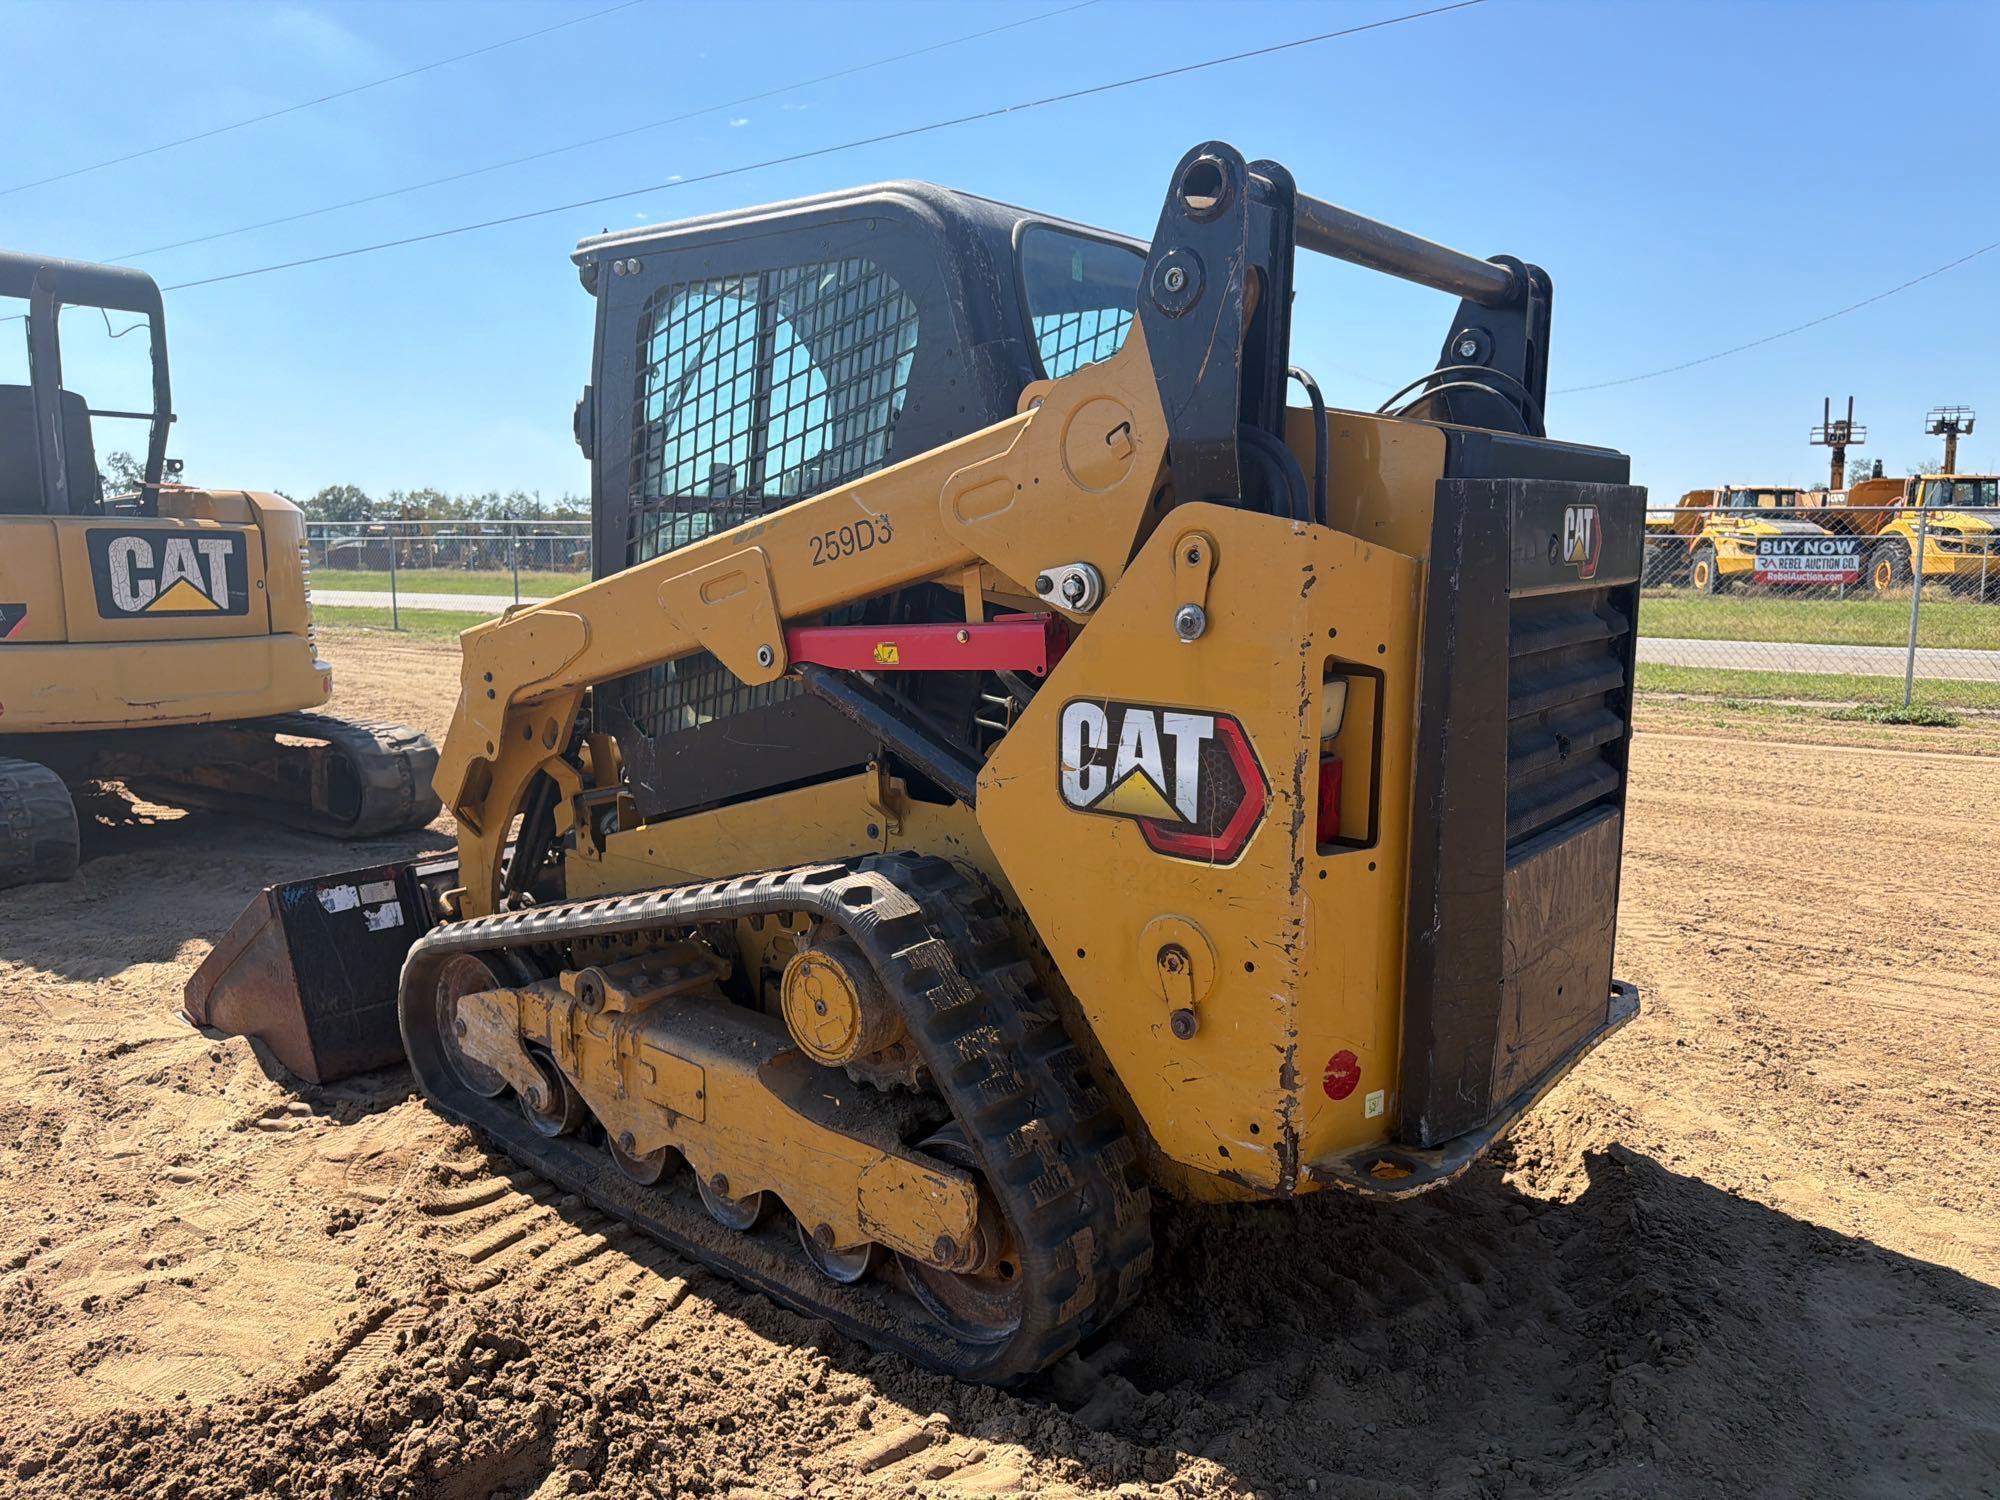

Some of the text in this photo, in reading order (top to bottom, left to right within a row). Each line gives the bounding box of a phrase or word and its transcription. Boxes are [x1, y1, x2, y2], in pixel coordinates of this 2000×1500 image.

[809, 516, 893, 567] 259D3
[1563, 507, 1593, 561] CAT
[1760, 540, 1856, 554] BUY NOW
[107, 536, 234, 612] CAT
[1766, 571, 1844, 581] RebelAuction.com
[1778, 558, 1802, 570] REBEL
[1804, 558, 1840, 570] AUCTION
[1842, 558, 1857, 570] CO.
[1062, 701, 1214, 824] CAT
